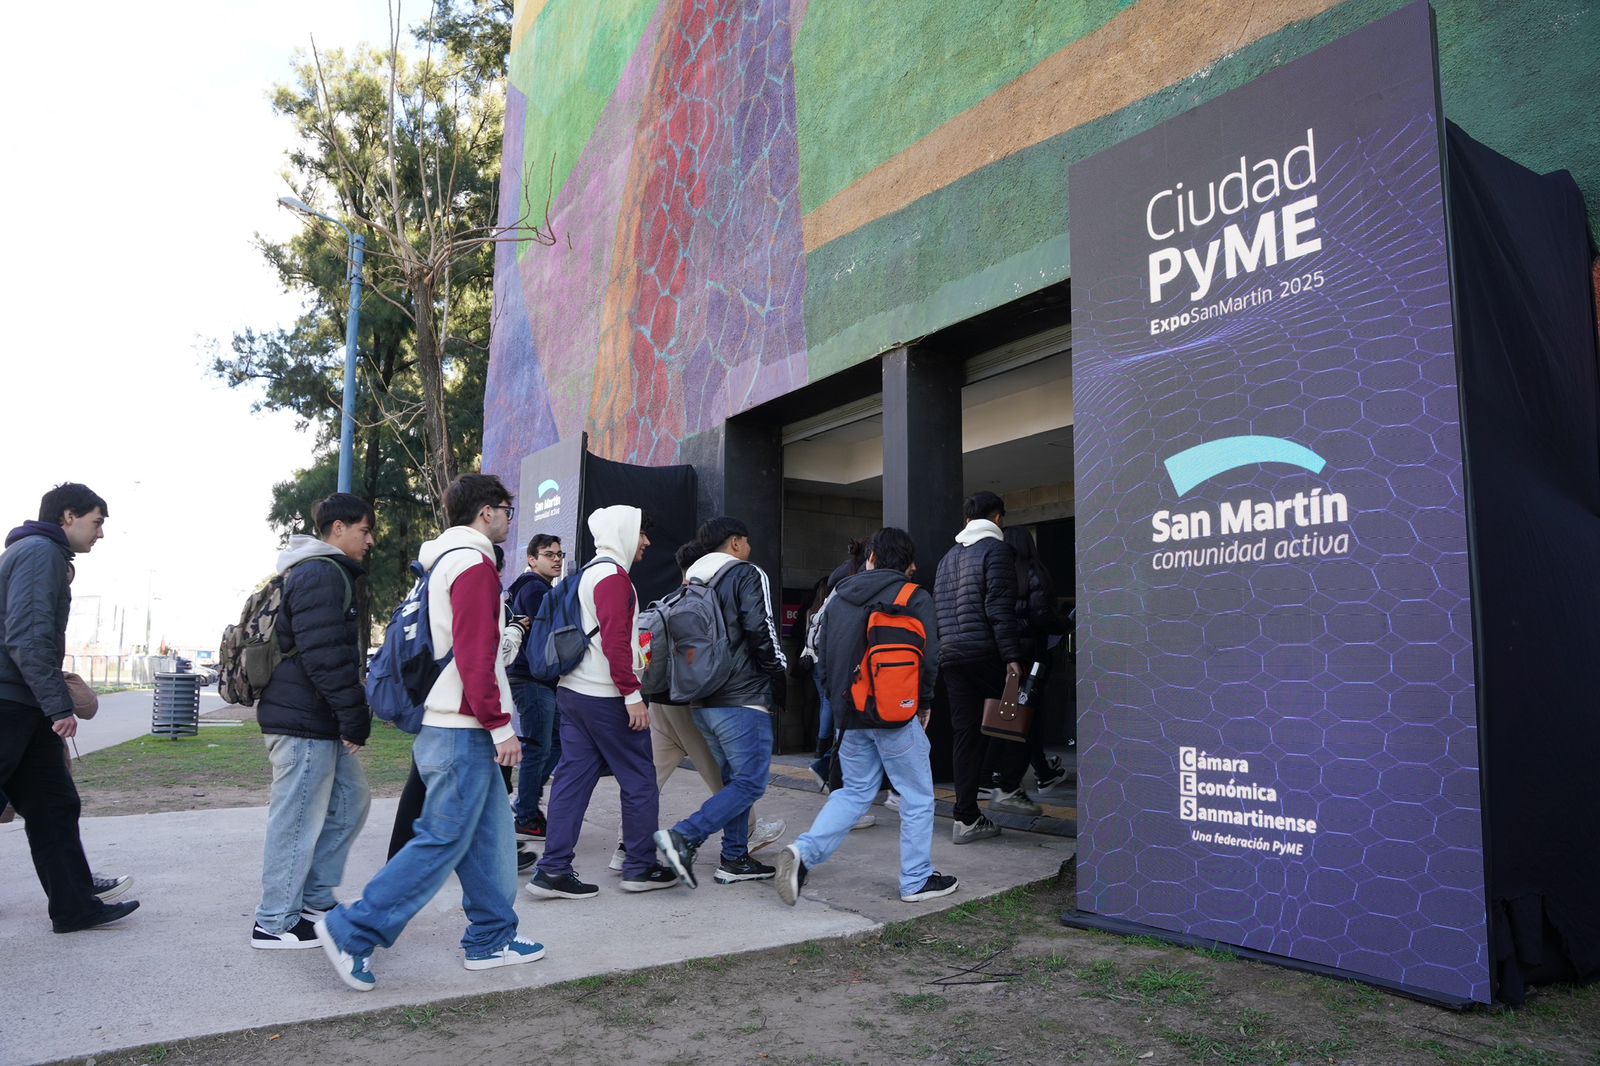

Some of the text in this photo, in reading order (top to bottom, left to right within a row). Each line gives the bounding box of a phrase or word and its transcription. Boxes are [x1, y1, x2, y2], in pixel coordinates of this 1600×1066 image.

[1146, 128, 1317, 241] Ciudad
[1148, 194, 1322, 304] PyME
[1150, 270, 1325, 336] ExpoSanMartín 2025
[1151, 487, 1349, 543] San Martín
[1152, 532, 1350, 571] comunidad activa
[1181, 749, 1249, 773] Cámara
[1181, 774, 1277, 802] Económica
[1181, 799, 1317, 834] Sanmartinense
[1192, 830, 1304, 856] Una federación PyME
